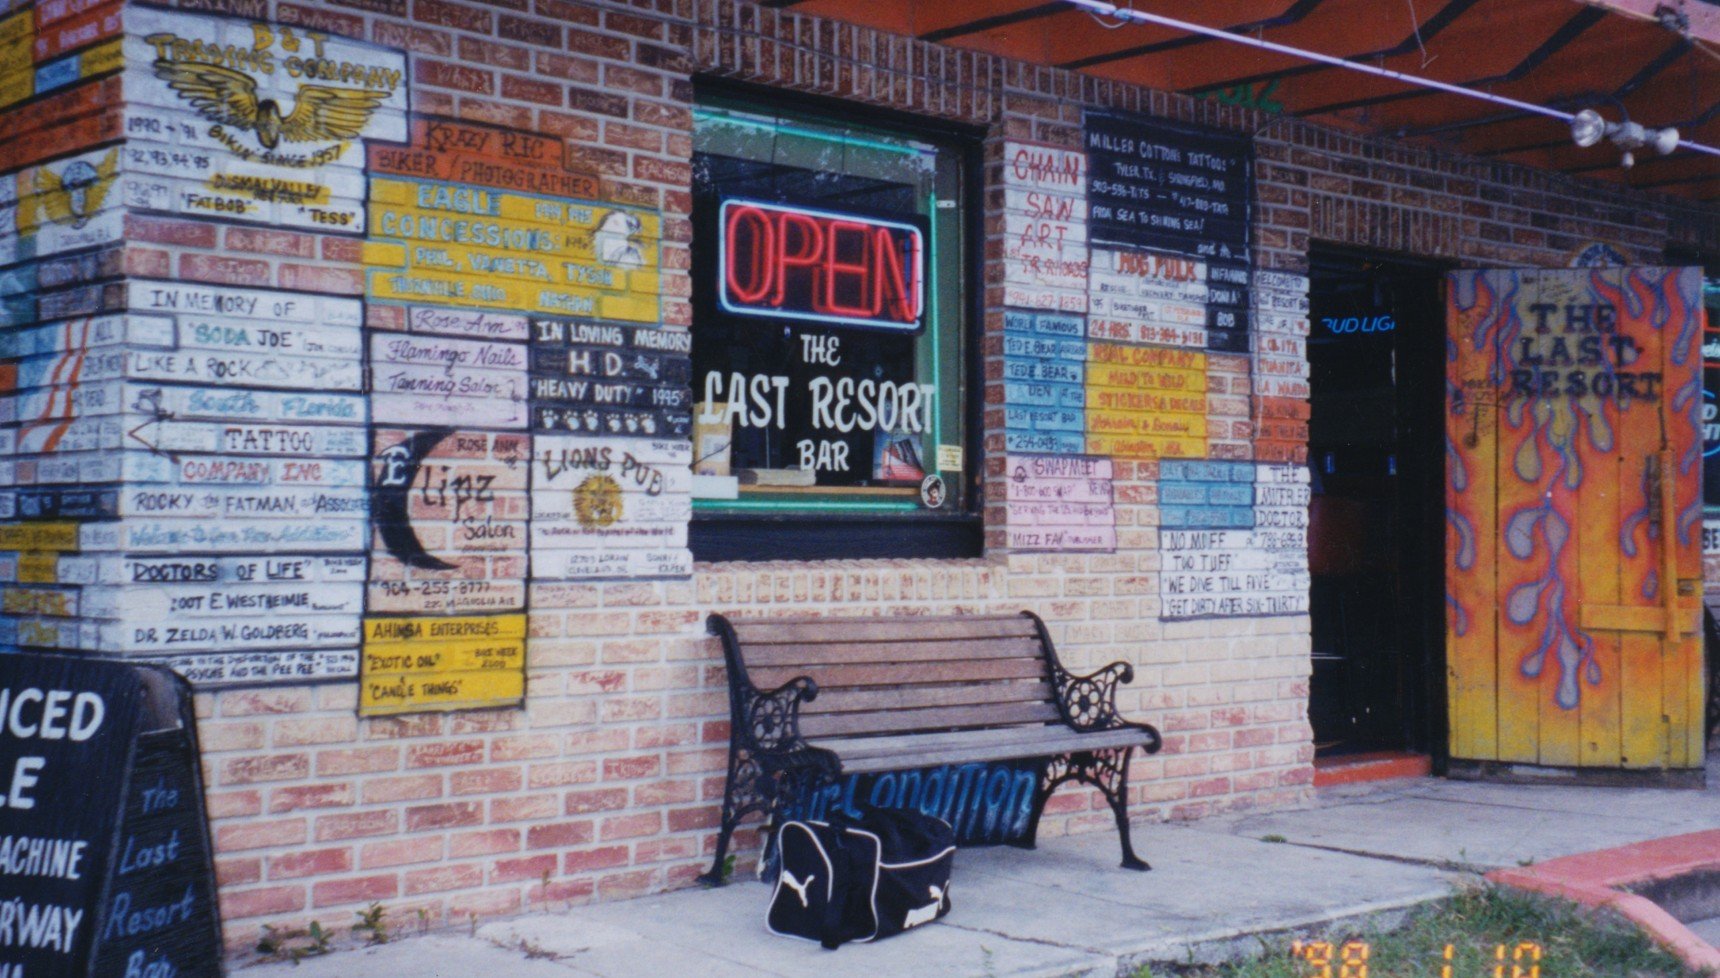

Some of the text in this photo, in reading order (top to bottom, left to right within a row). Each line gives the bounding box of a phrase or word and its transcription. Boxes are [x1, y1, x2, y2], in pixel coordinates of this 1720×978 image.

[253, 24, 330, 58] D & T
[145, 34, 400, 91] TRADING COMPANY
[424, 122, 488, 153] KRAZY
[1089, 132, 1135, 154] MILLER
[377, 151, 436, 175] BIKER
[461, 164, 594, 198] PHOTOGRAPHER
[1013, 148, 1079, 186] CHAIN
[1112, 162, 1139, 181] TYLER
[417, 184, 501, 216] EAGLE
[1025, 191, 1075, 222] SAW
[1116, 207, 1136, 221] SEA
[1138, 211, 1149, 225] TO
[1150, 214, 1182, 230] SHINING
[1020, 223, 1068, 252] ART
[726, 203, 919, 322] OPEN
[151, 289, 297, 317] IN MEMORY OF
[415, 309, 459, 330] Rose
[1038, 319, 1079, 334] FAMOUS
[1216, 311, 1236, 328] BOB
[1529, 302, 1617, 335] THE
[536, 321, 692, 351] IN LOVING MEMORY
[800, 334, 841, 367] THE
[184, 358, 198, 374] A
[385, 340, 471, 378] Flamingo
[473, 344, 522, 367] Nails
[1519, 336, 1636, 367] LAST
[388, 371, 503, 401] Tanning Salon
[1008, 363, 1069, 381] TED BEAR
[1508, 369, 1664, 403] RESORT
[187, 388, 357, 418] South Florida
[699, 370, 935, 434] LAST RESORT
[1028, 385, 1052, 397] DEN
[1008, 409, 1029, 422] LAST
[224, 427, 314, 453] TATTOO
[458, 438, 488, 452] ROSE
[796, 438, 850, 472] BAR
[542, 446, 663, 497] LIONS PUB
[1269, 466, 1299, 483] THE
[132, 491, 195, 513] ROCKY
[462, 515, 516, 541] Salon
[1256, 510, 1304, 527] DOCTOR
[237, 563, 258, 580] OF
[165, 625, 217, 643] ZELDA
[241, 622, 309, 641] GOLDBERG
[430, 621, 500, 637] ENTERPRISES
[141, 776, 179, 815] The
[119, 828, 182, 875] Last
[104, 884, 197, 942] Resort
